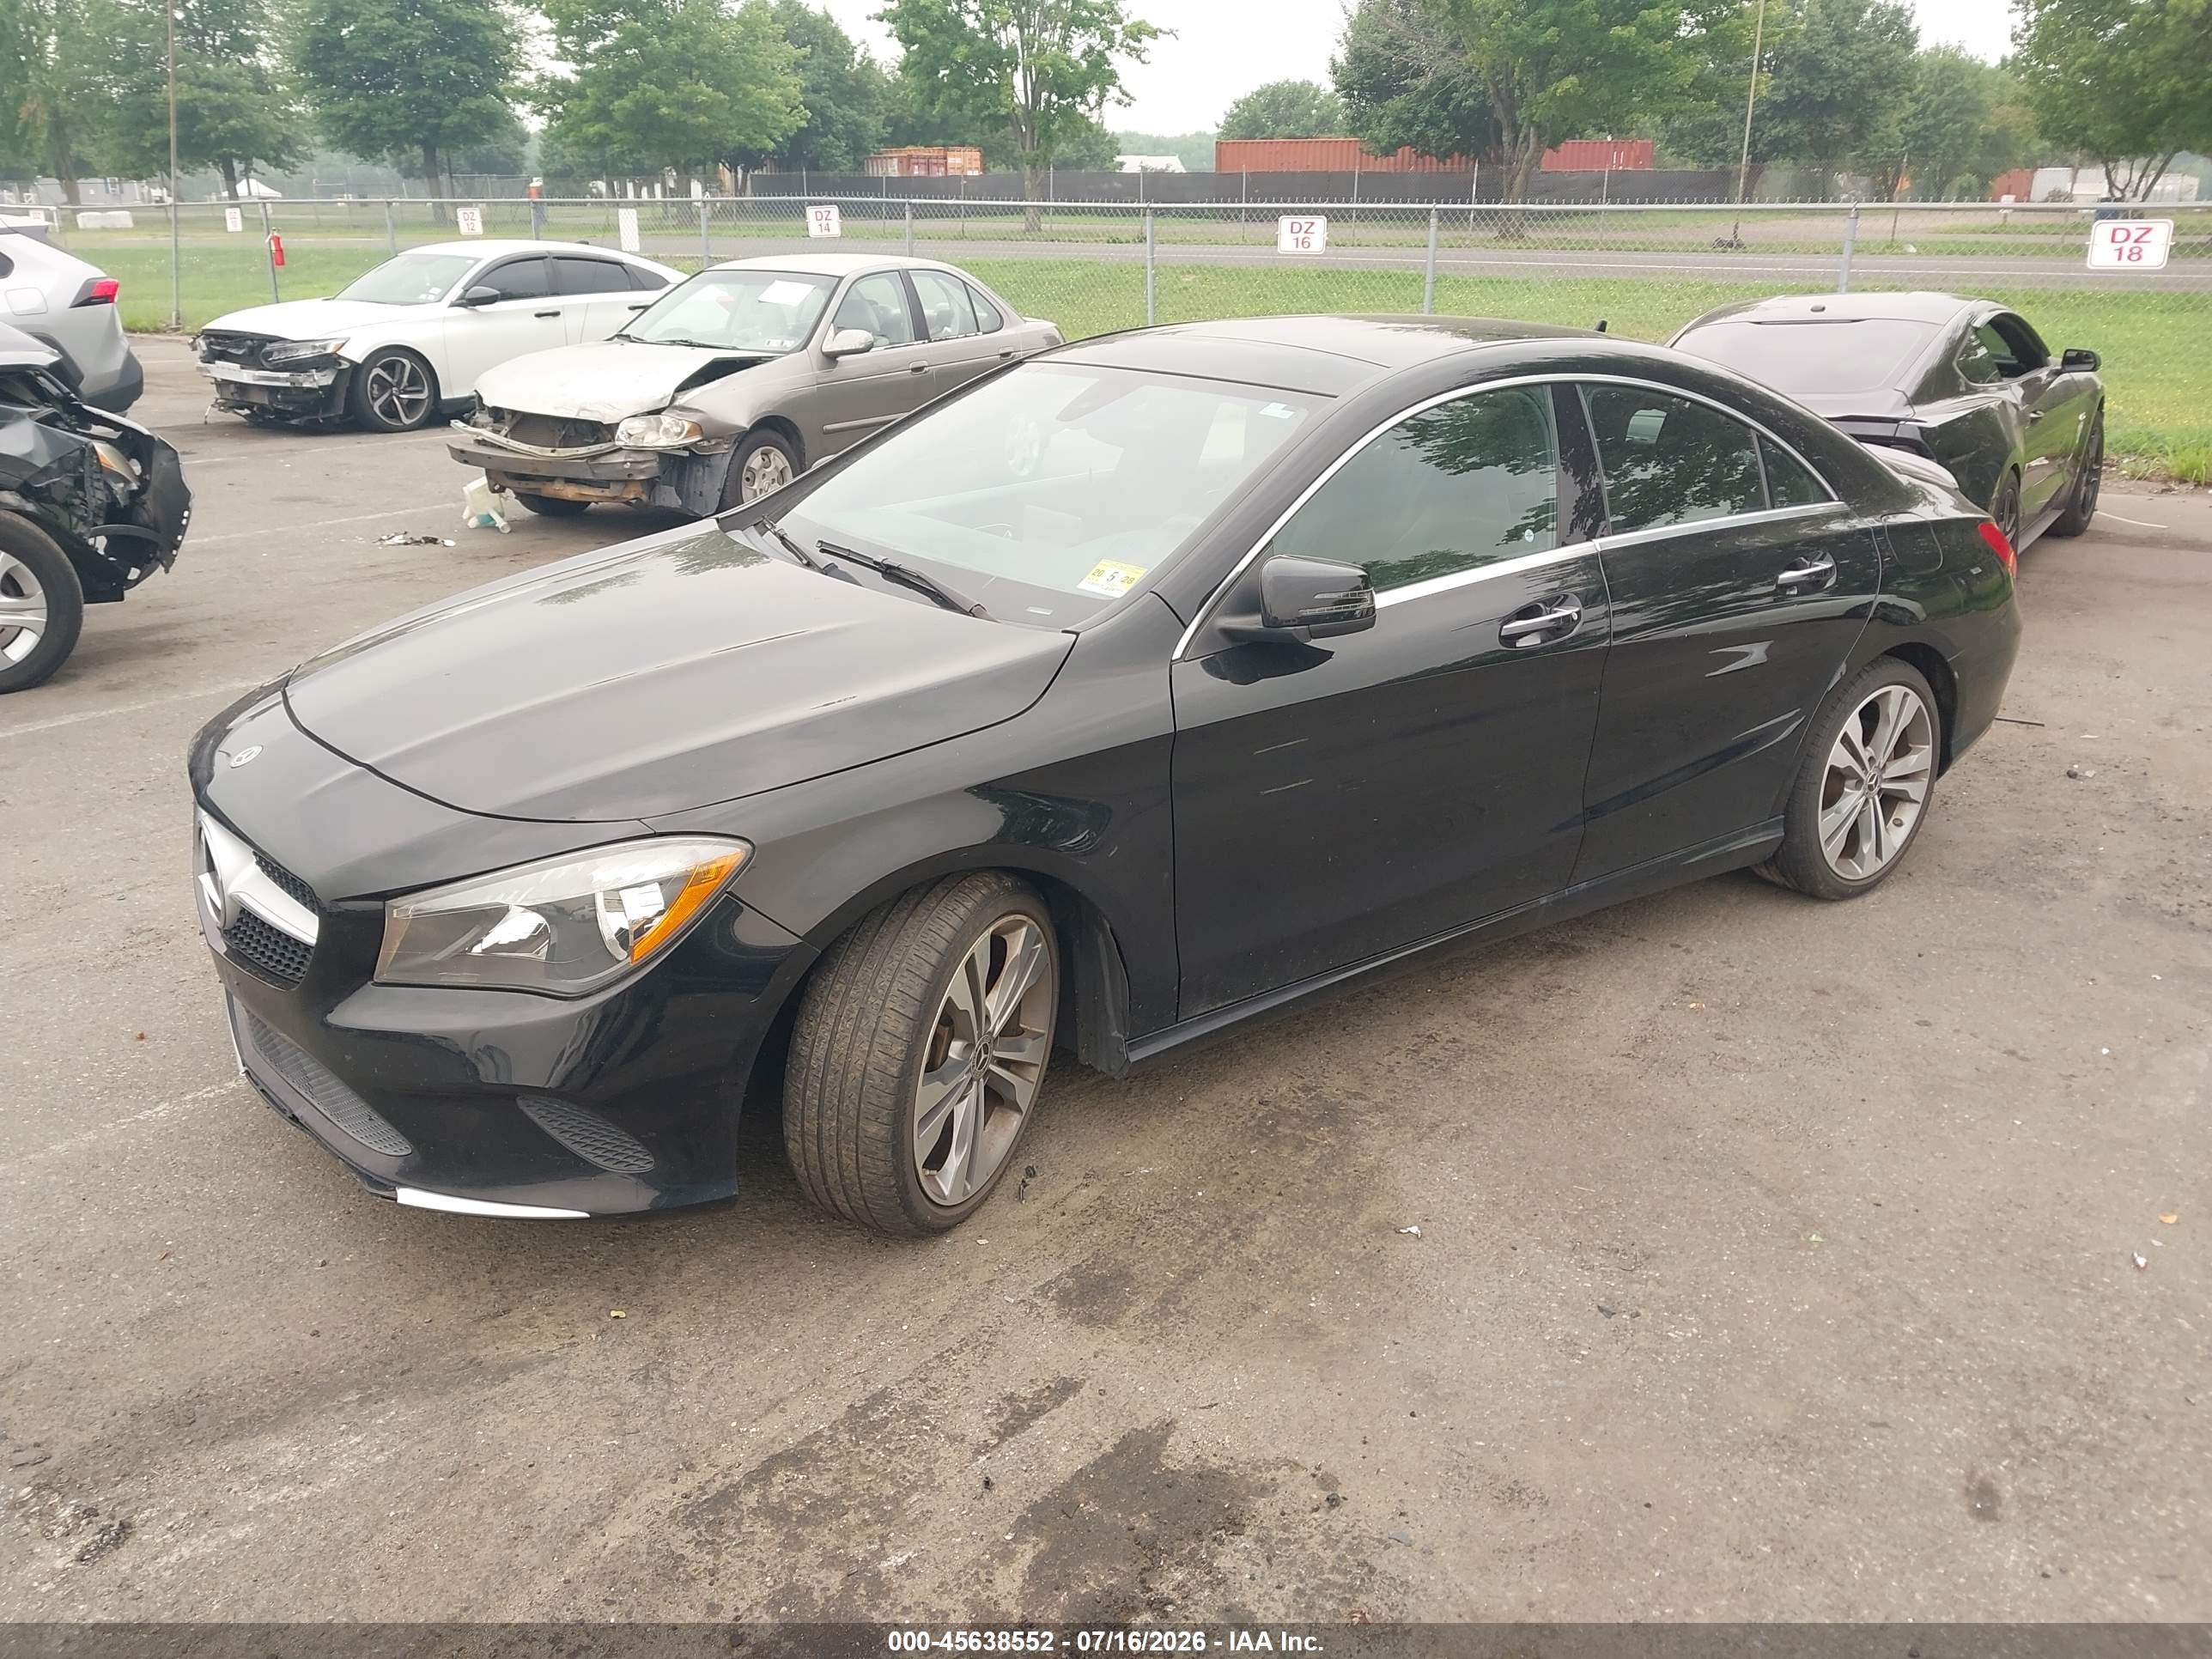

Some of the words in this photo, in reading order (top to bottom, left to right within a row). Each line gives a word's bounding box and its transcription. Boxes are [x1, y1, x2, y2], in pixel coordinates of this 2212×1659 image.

[463, 211, 476, 221] DZ
[815, 210, 831, 221] DZ
[818, 222, 830, 233] 14
[1290, 222, 1315, 234] DZ
[2110, 227, 2154, 243] DZ
[1292, 236, 1311, 249] 16
[2113, 246, 2143, 262] 18
[1106, 571, 1120, 582] 5
